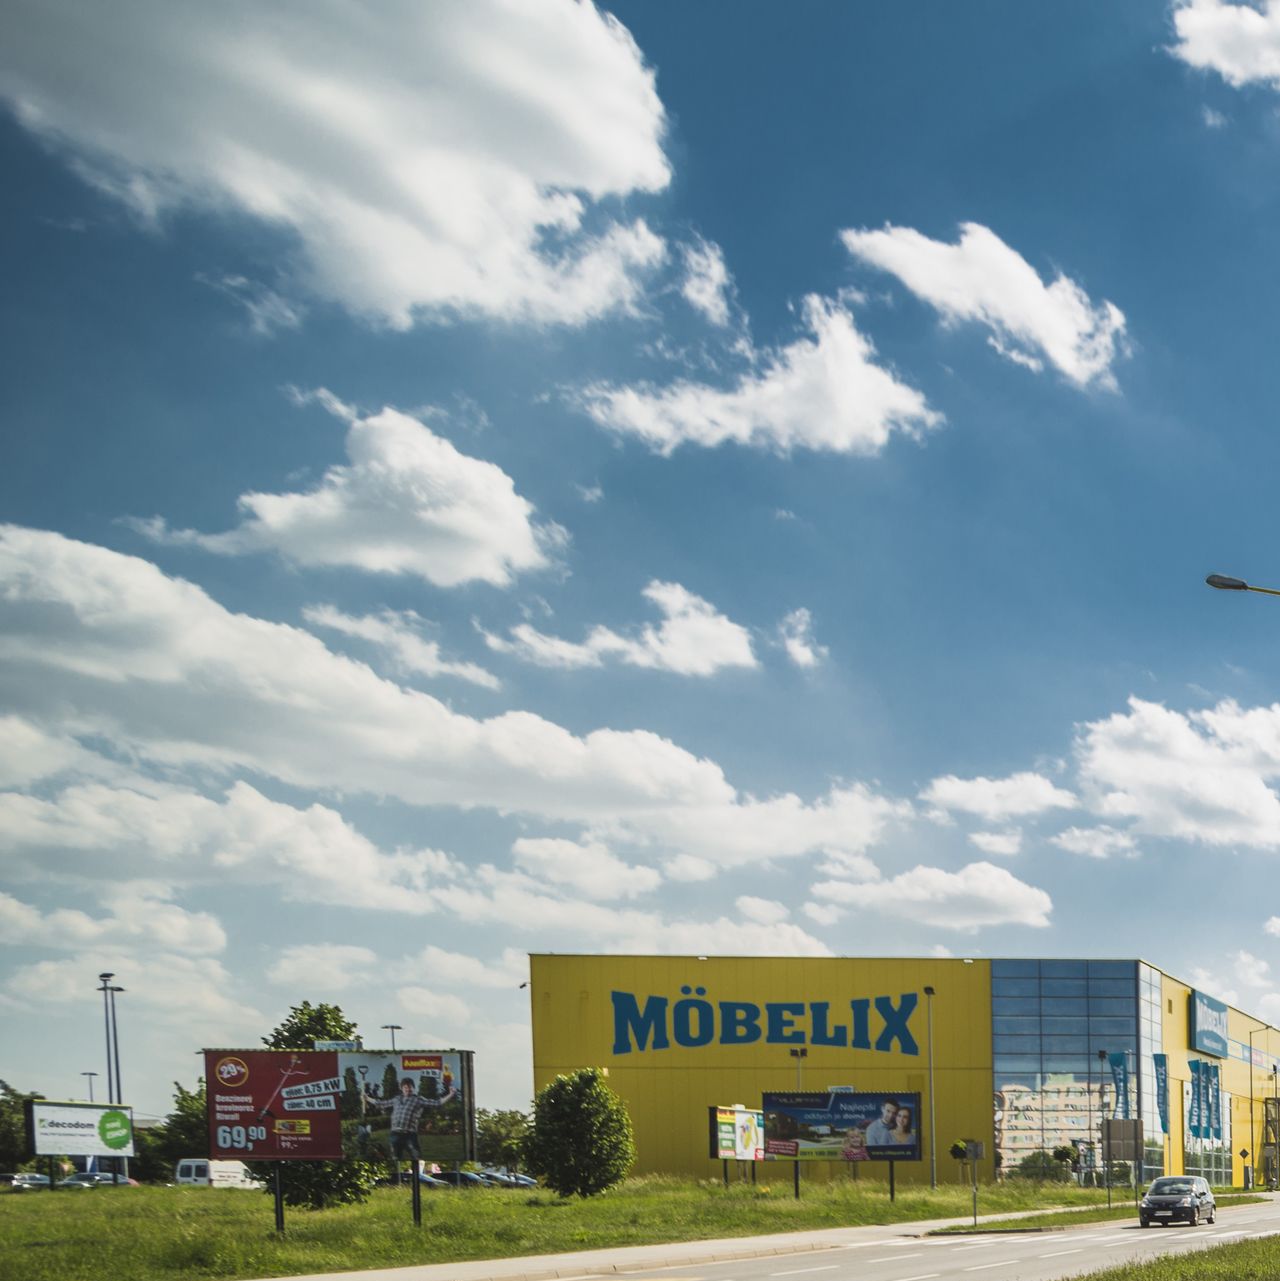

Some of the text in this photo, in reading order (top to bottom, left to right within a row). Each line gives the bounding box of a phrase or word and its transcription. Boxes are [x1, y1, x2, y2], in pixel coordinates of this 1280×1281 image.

[611, 985, 919, 1057] MÖBELIX
[323, 1079, 340, 1091] kW
[317, 1099, 332, 1107] cm
[48, 1120, 95, 1129] decodom
